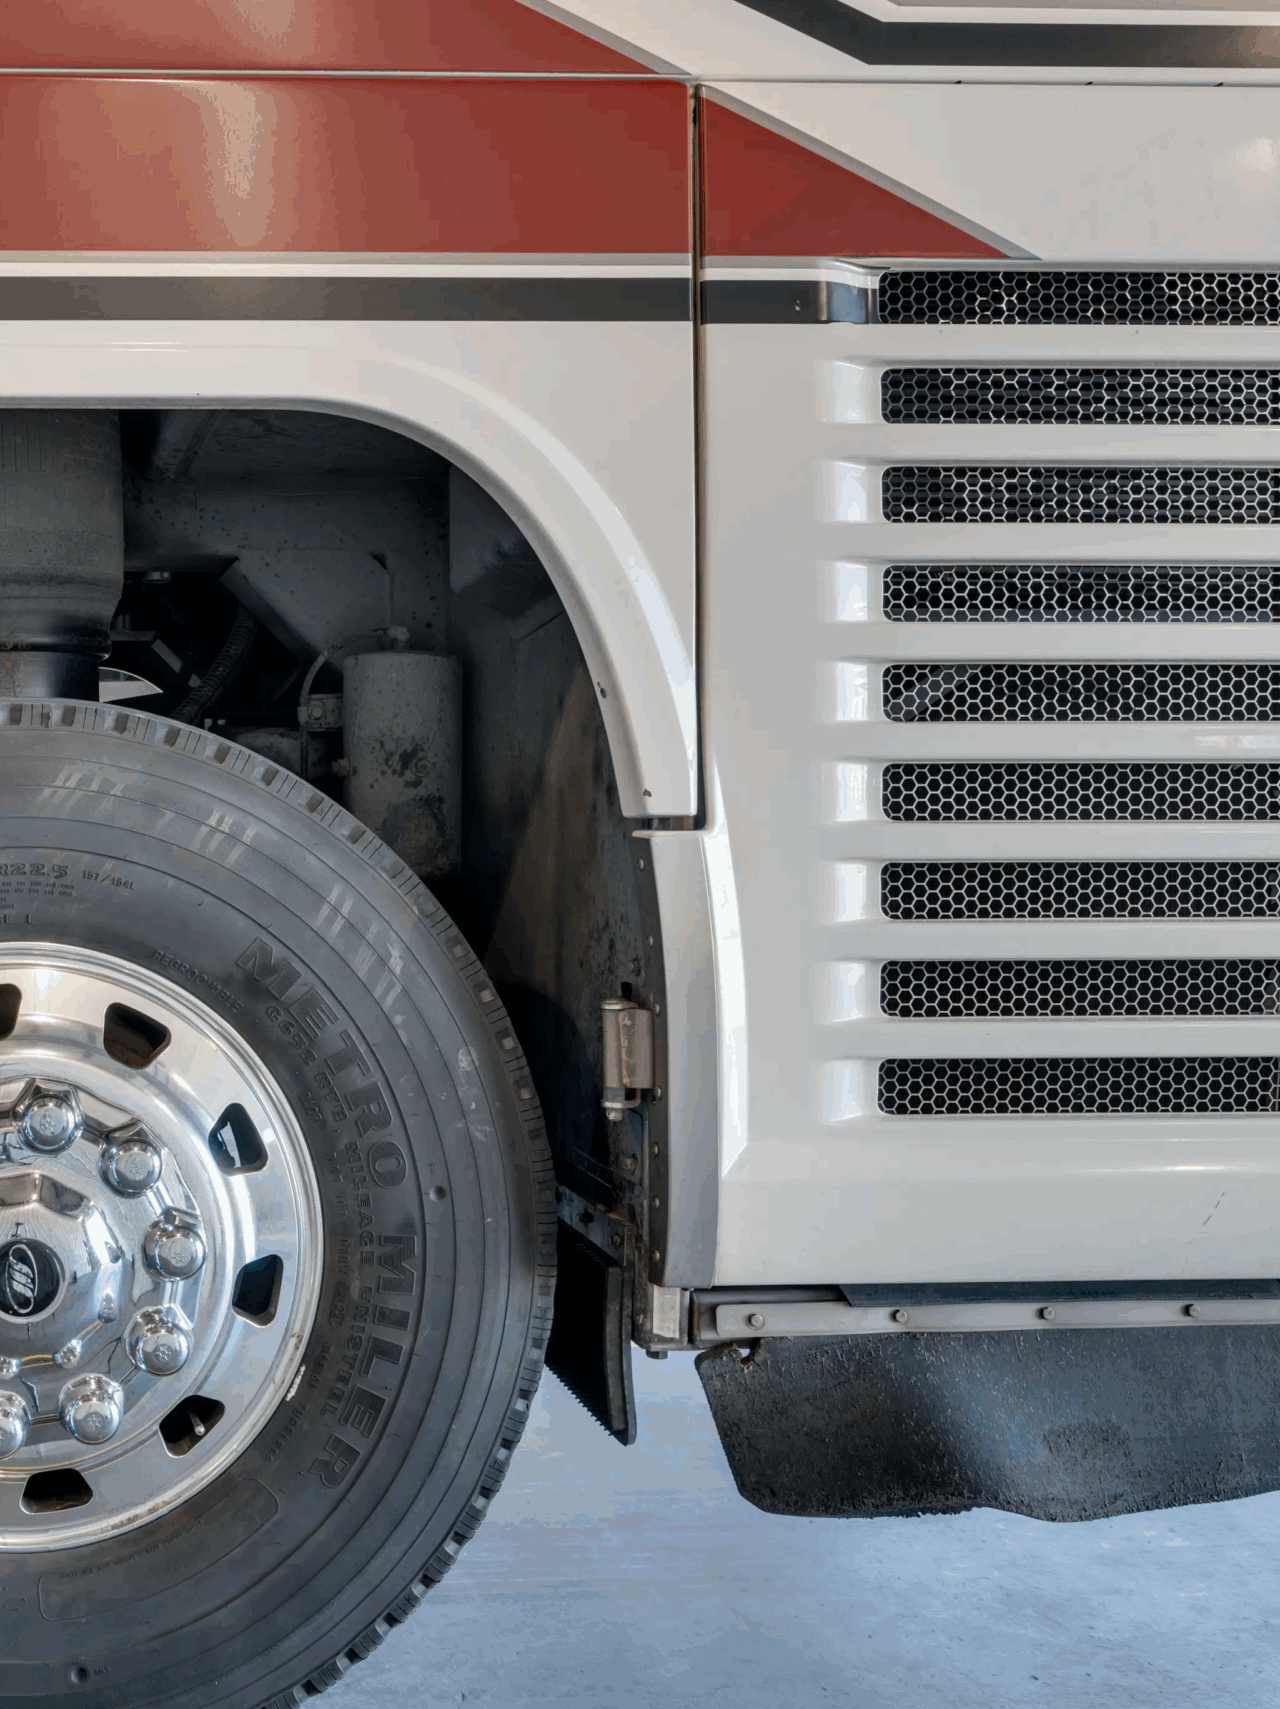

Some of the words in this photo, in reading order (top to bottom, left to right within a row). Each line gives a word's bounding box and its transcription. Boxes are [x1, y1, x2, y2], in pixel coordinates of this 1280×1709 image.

[25, 913, 35, 926] L
[81, 868, 136, 891] 157/154L
[235, 936, 410, 1190] METRO
[266, 1004, 316, 1068] G652
[315, 1070, 348, 1125] RTB
[344, 1140, 375, 1267] MILEAGE
[311, 1233, 418, 1490] MILER
[321, 1286, 374, 1420] UNISTEEL
